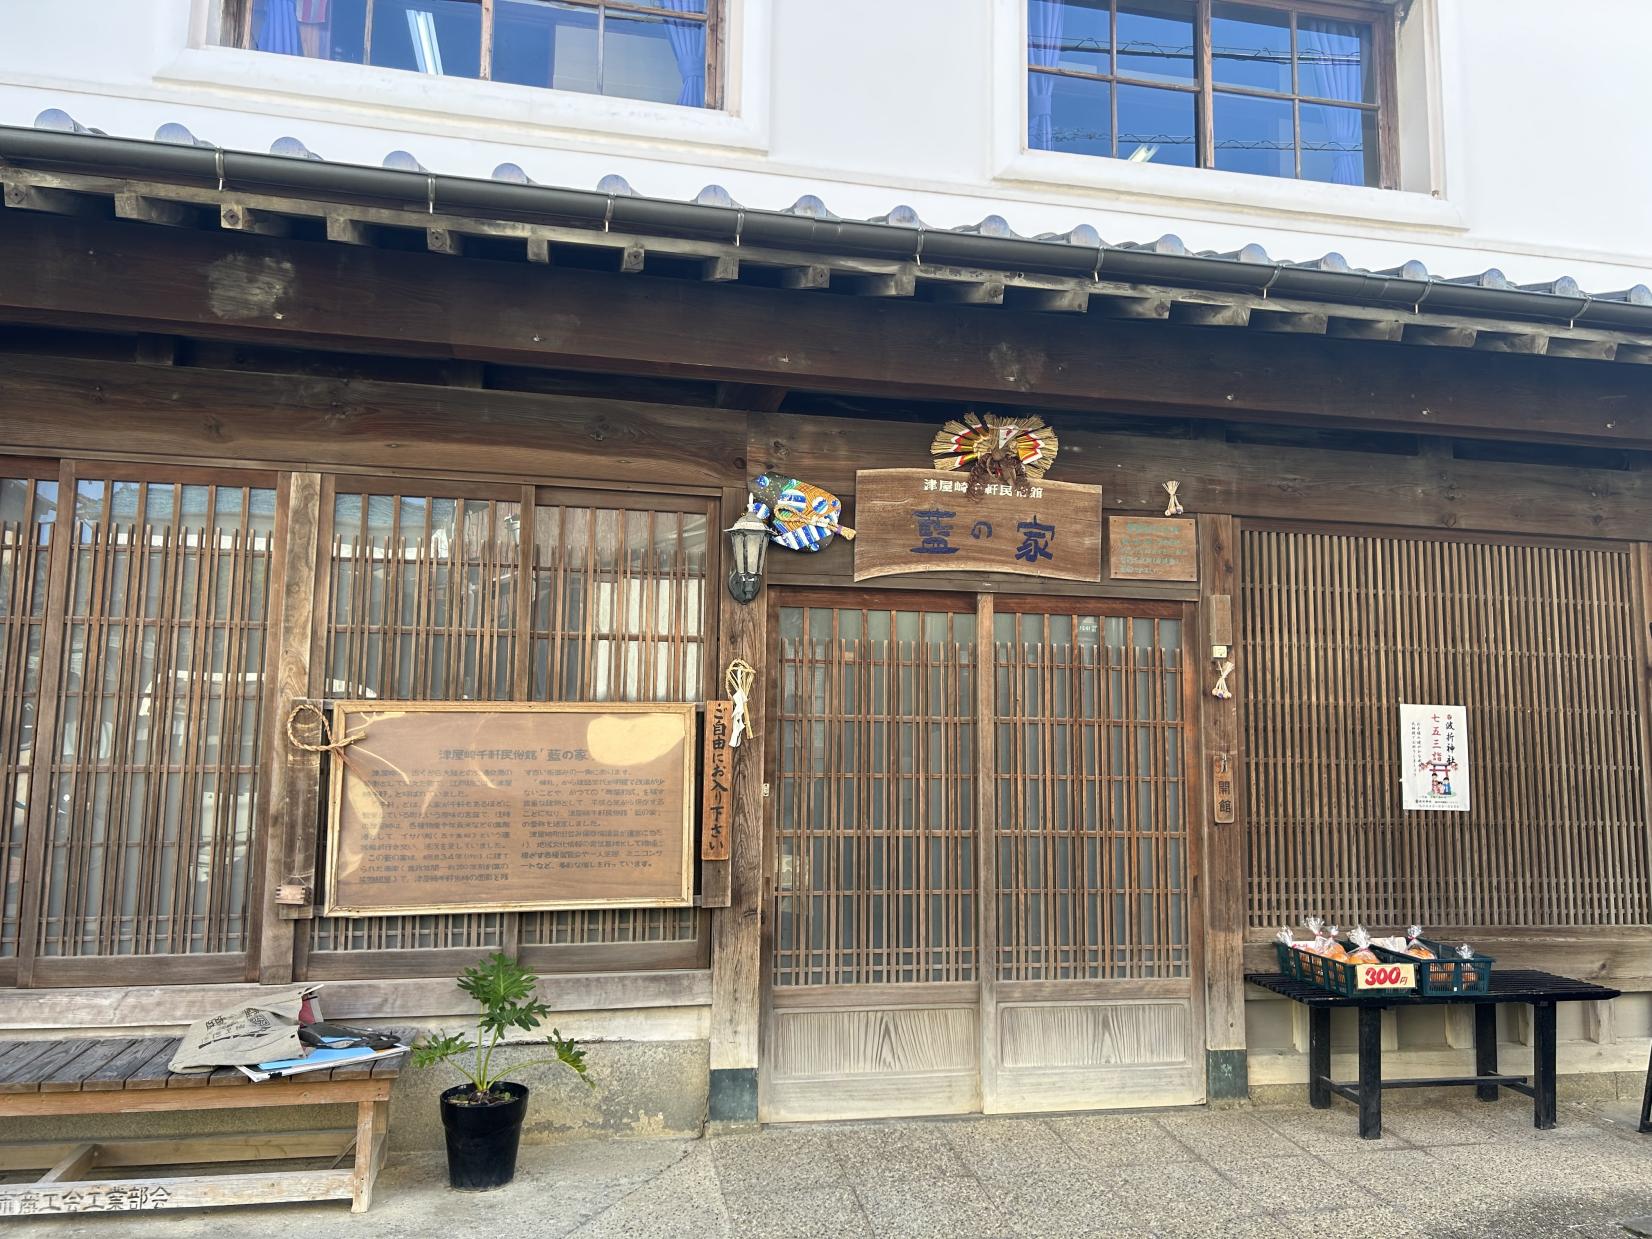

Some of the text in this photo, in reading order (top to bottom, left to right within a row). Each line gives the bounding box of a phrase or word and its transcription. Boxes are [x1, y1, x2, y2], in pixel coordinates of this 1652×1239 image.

[909, 507, 1056, 564] 藍の家
[1431, 713, 1442, 762] 七五三詣
[1445, 721, 1456, 764] 波折神社
[709, 706, 728, 851] ご自由にお入り下さい
[1218, 780, 1232, 813] 開館
[1364, 966, 1408, 986] 300円
